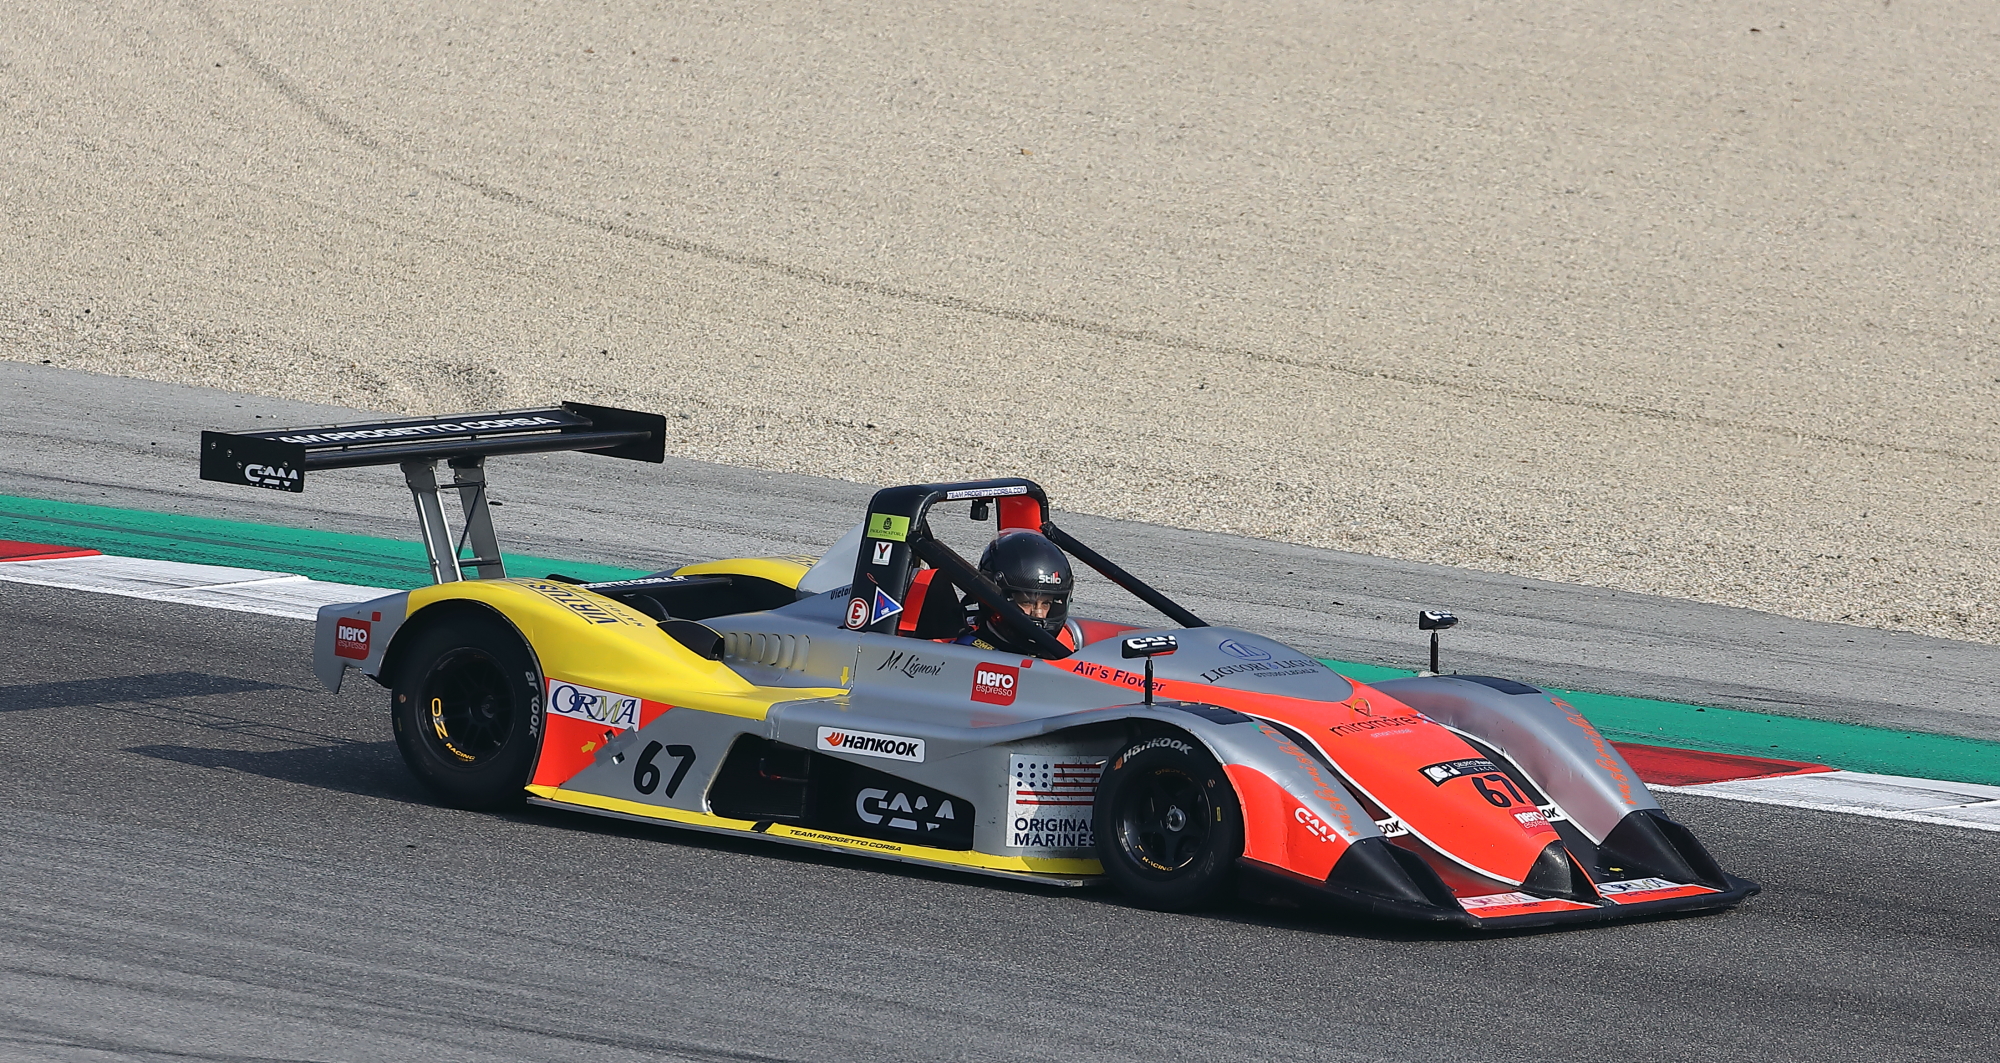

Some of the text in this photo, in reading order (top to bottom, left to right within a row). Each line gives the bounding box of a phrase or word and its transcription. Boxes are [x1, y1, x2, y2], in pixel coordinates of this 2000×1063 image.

[320, 423, 467, 441] PROGETTO
[460, 416, 562, 430] CORSA
[878, 543, 890, 559] Y
[1038, 572, 1062, 585] Stilo
[851, 603, 863, 619] E
[338, 625, 367, 643] nero
[338, 640, 367, 650] espresso
[876, 650, 903, 671] M.
[977, 670, 1014, 688] nero
[1073, 661, 1109, 679] Air's
[1200, 662, 1267, 683] LIGUORI
[975, 685, 1013, 697] espresso
[551, 684, 637, 725] ORMA
[445, 742, 476, 760] RACING
[633, 740, 697, 799] 67
[1471, 774, 1526, 808] 67
[1514, 811, 1545, 824] nero
[1542, 807, 1561, 819] OK
[789, 829, 902, 852] TEAM PROGETTO CORSA
